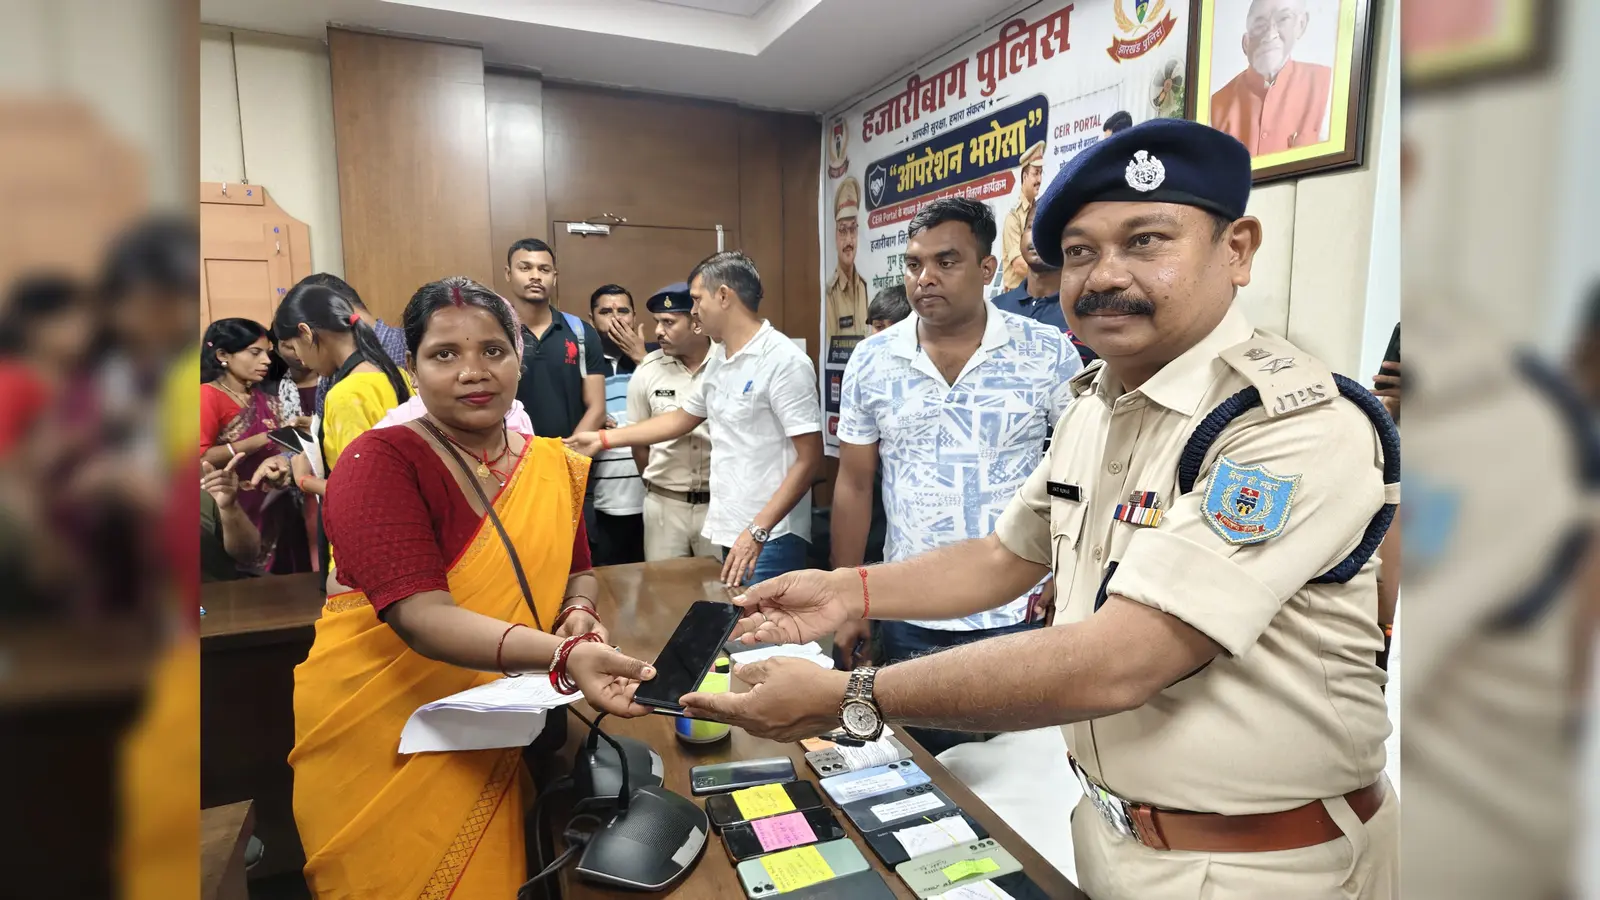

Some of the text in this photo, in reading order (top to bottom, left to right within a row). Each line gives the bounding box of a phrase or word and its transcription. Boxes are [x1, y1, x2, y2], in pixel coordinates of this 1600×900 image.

[1142, 27, 1163, 51] पुलिस
[862, 3, 1074, 144] हजारीबाग पुलिस
[912, 122, 929, 140] आपकी
[949, 110, 965, 126] हमारा
[966, 100, 986, 117] संकल्प
[1054, 114, 1101, 139] CEIR PORTAL
[1054, 145, 1059, 155] के
[1078, 138, 1083, 149] से
[247, 189, 252, 197] 2
[883, 210, 897, 221] Portal
[898, 206, 902, 217] के
[966, 186, 982, 198] वितरण
[983, 178, 1006, 194] कार्यक्रम
[871, 234, 896, 252] हजारीबाग
[887, 255, 896, 271] गुम
